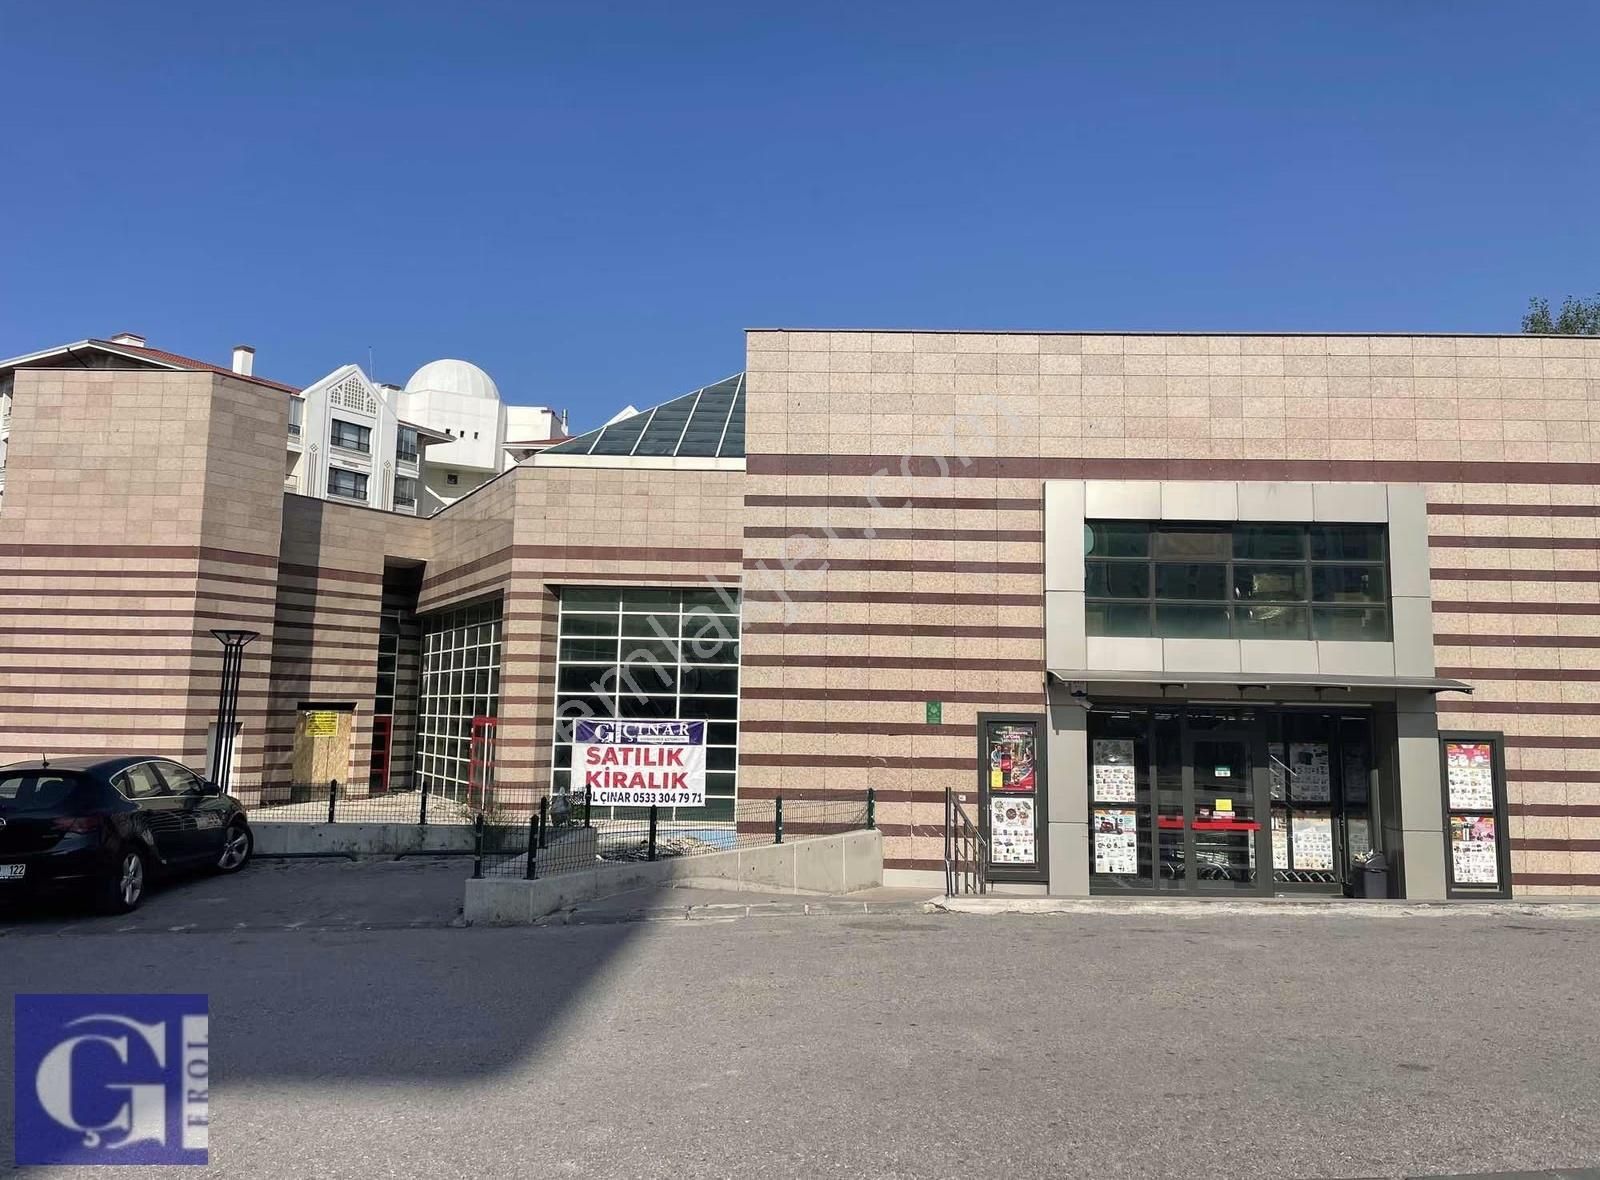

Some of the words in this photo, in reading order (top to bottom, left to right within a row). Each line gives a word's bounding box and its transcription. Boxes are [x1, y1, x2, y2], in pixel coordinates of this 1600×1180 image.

[623, 723, 689, 742] ÇINAR
[586, 747, 684, 766] SATILIK
[585, 767, 689, 789] KİRALIK
[573, 792, 598, 802] ERL
[601, 792, 630, 804] ÇINAR
[633, 792, 656, 803] 0533
[659, 793, 676, 803] 304
[679, 793, 690, 803] 79
[692, 793, 702, 803] 71
[10, 865, 24, 874] 122
